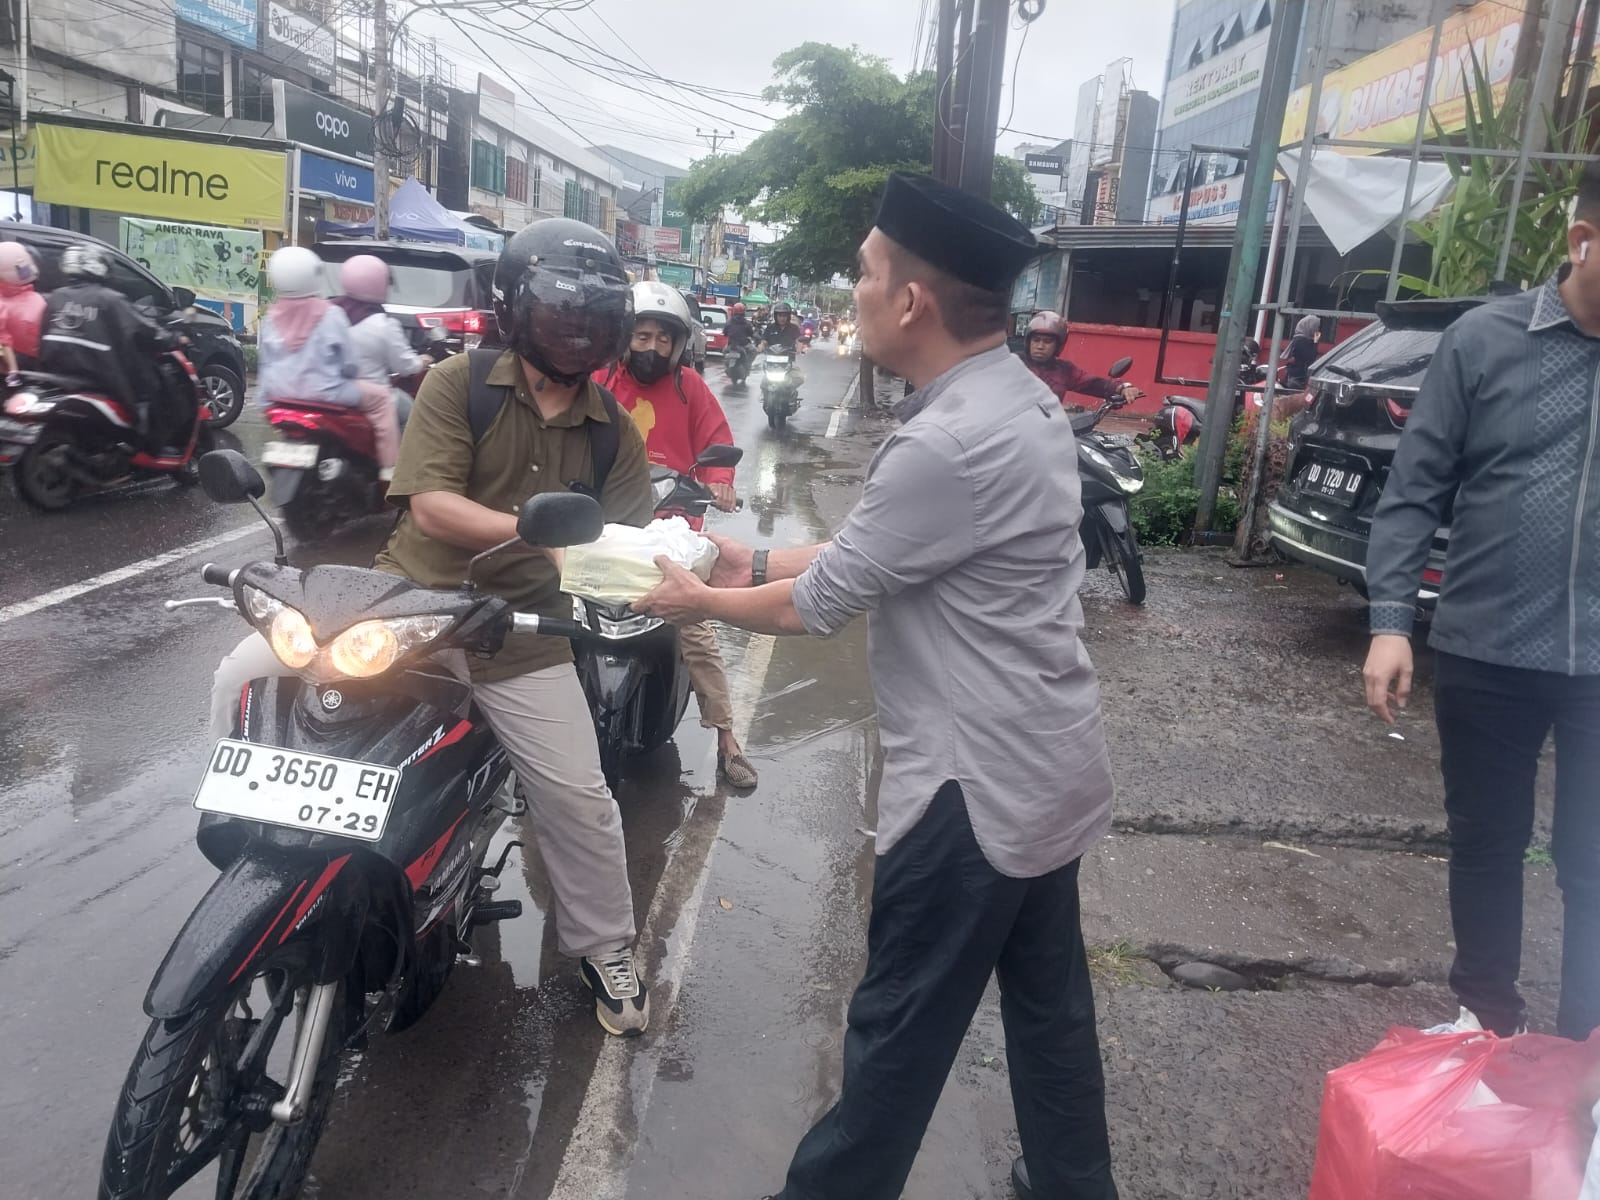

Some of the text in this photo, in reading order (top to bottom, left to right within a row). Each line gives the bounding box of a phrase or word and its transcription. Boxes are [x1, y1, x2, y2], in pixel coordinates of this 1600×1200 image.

[315, 111, 350, 140] oppo
[1028, 160, 1059, 169] SAMSUNG
[95, 159, 229, 201] realme
[335, 170, 357, 189] vivo
[1173, 185, 1218, 211] KMPUS
[155, 223, 224, 240] ANEKA RAYA
[1322, 468, 1345, 489] 1720
[1346, 473, 1362, 493] LB
[212, 745, 395, 803] DD 3650 EH
